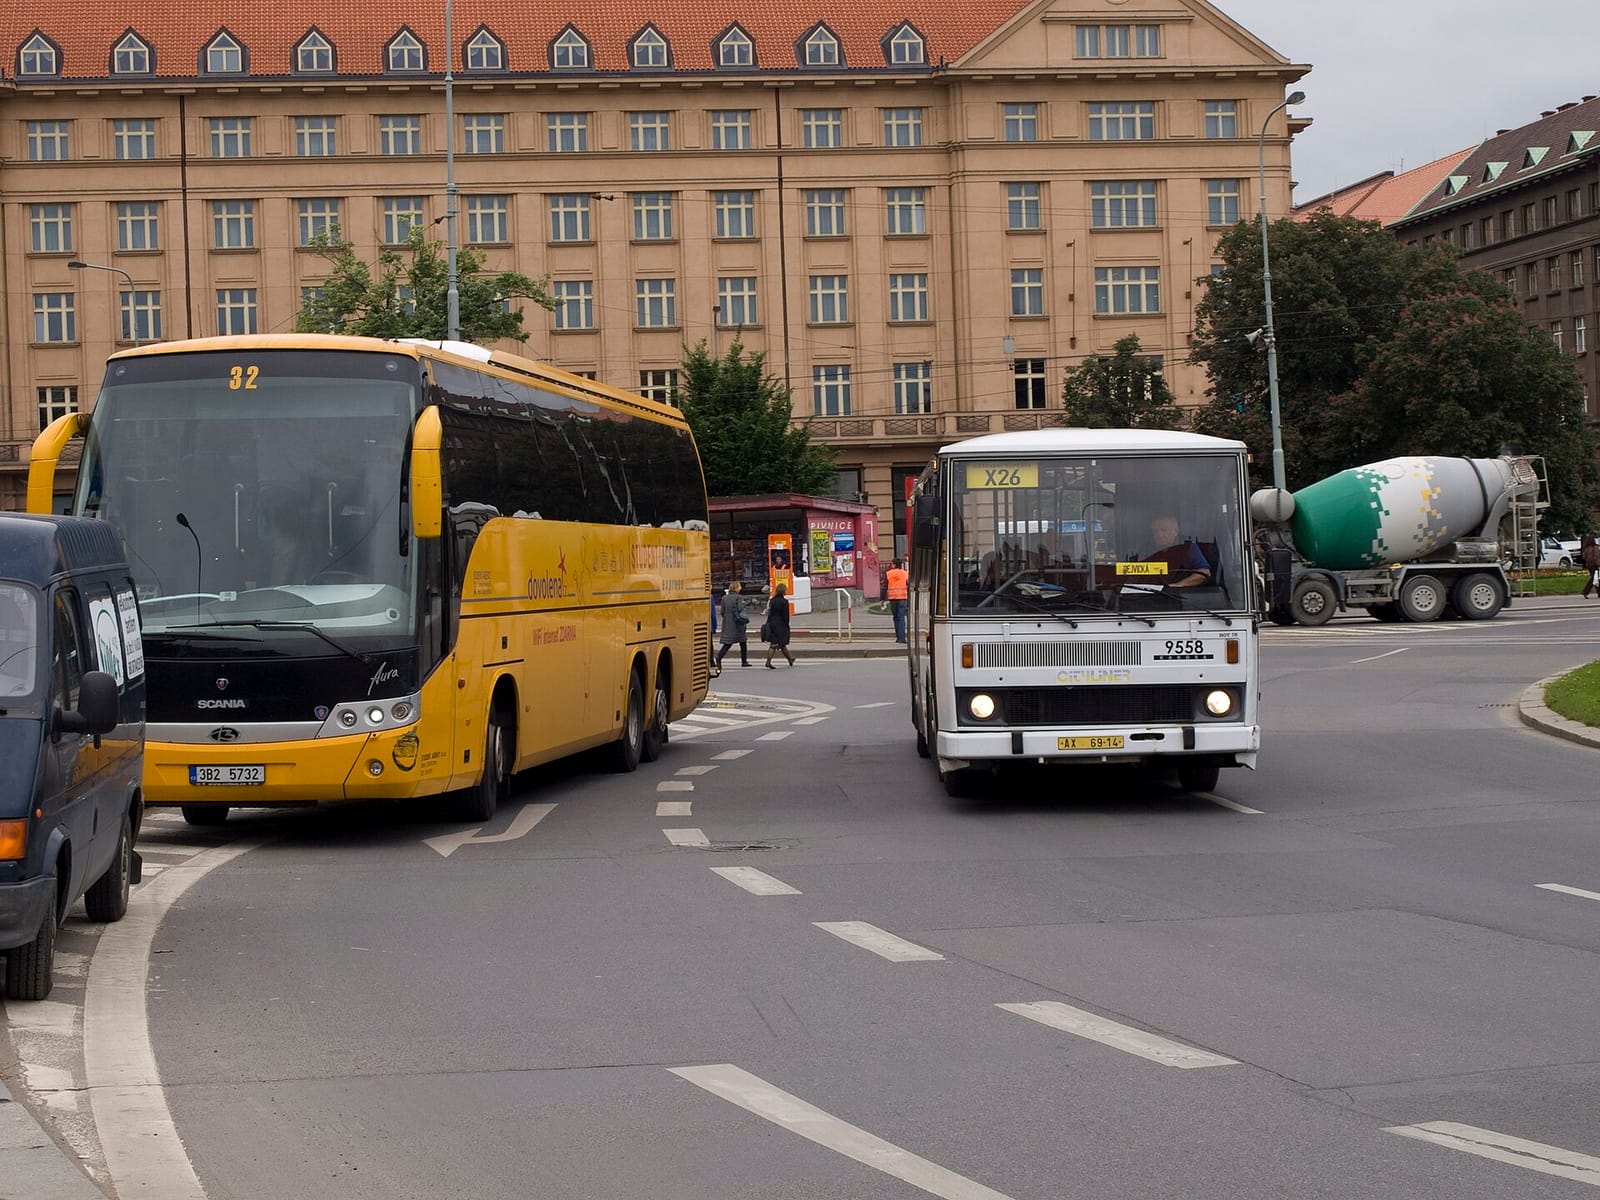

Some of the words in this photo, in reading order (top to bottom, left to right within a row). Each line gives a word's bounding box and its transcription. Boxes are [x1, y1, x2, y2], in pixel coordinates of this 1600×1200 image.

[229, 365, 259, 390] 32
[984, 469, 1021, 486] X26
[810, 521, 852, 530] PIVNICE
[1165, 640, 1204, 654] 9558
[367, 661, 399, 696] Aura
[197, 699, 246, 709] SCANIA
[1064, 738, 1077, 748] AX
[199, 768, 221, 781] 3B2
[229, 768, 259, 780] 5732
